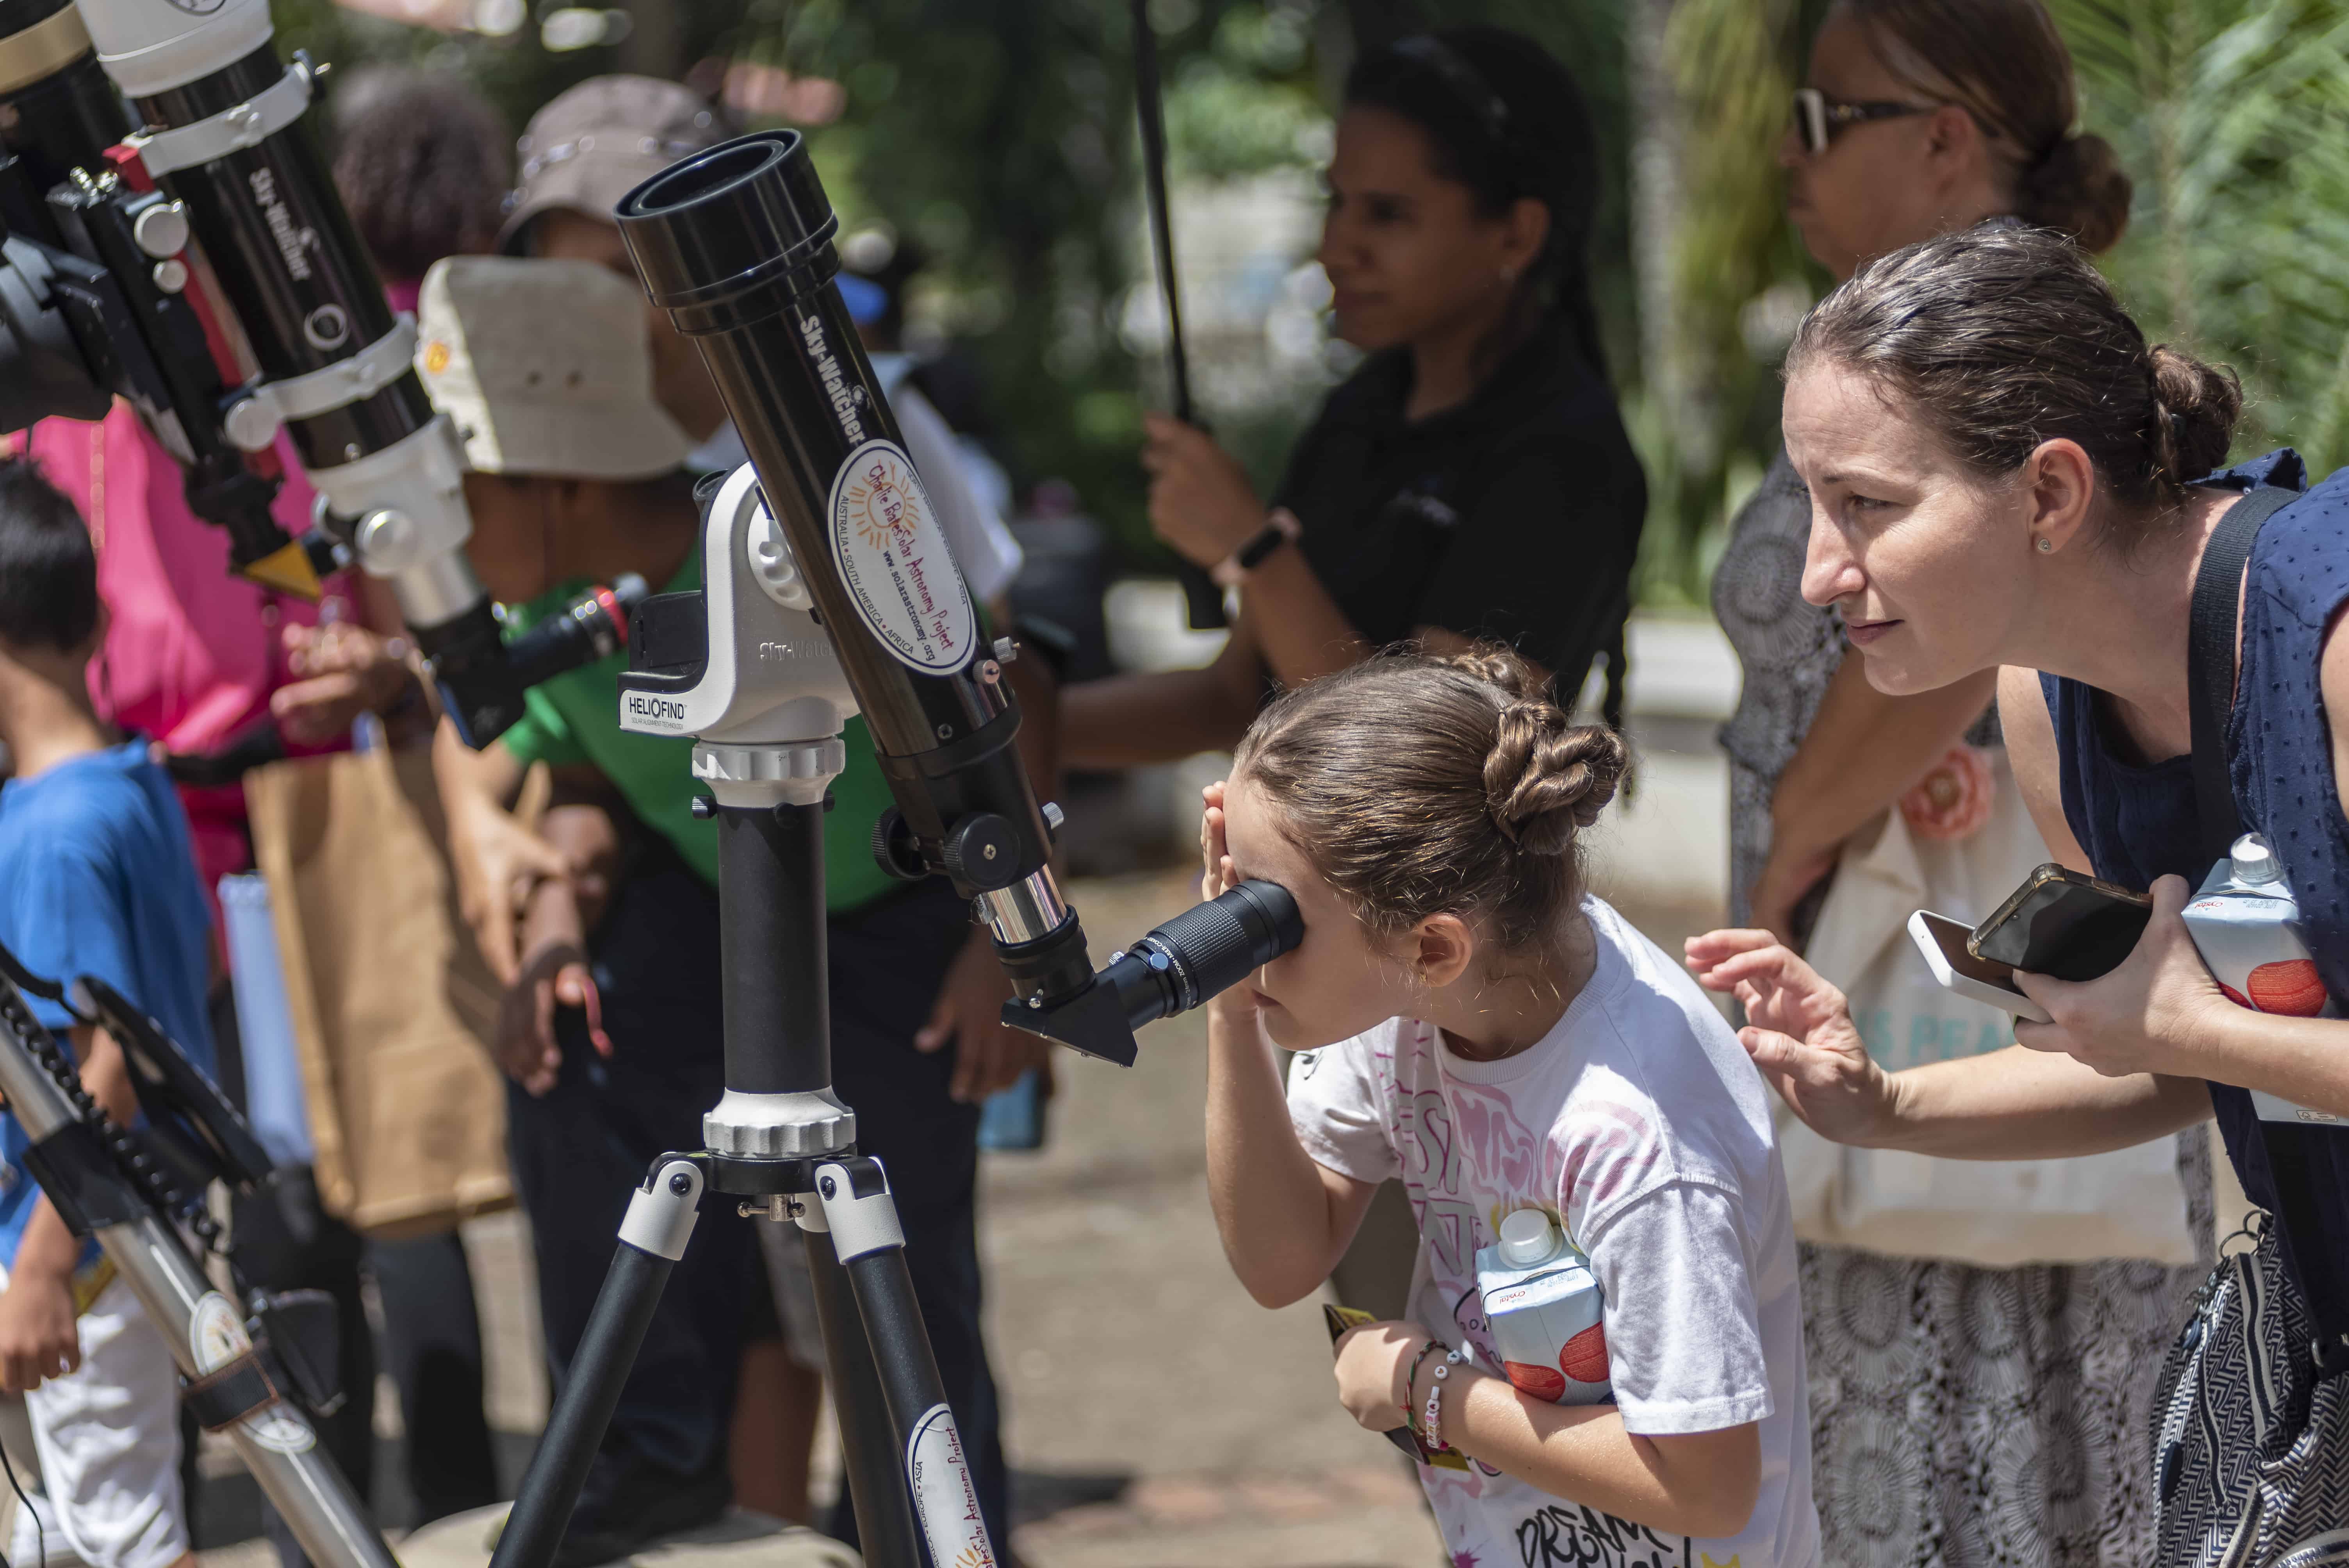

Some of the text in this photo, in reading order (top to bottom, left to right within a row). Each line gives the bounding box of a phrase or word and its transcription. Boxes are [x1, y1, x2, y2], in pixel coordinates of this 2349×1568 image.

[800, 315, 865, 446] Sky-Watcher
[839, 495, 914, 654] AUSTRALIA SOUTH AMERICA AFRICA
[869, 465, 892, 504] Charlie
[905, 557, 935, 615] Astronomy
[929, 609, 954, 651] Project
[882, 550, 936, 661] www.solarastronomy.org
[958, 583, 966, 605] ASIA
[1173, 959, 1185, 976] ZOOM
[1499, 1290, 1525, 1304] Crystal
[945, 1426, 964, 1464] Project
[917, 1492, 928, 1528] EUROPE
[959, 1467, 980, 1520] Astronomy
